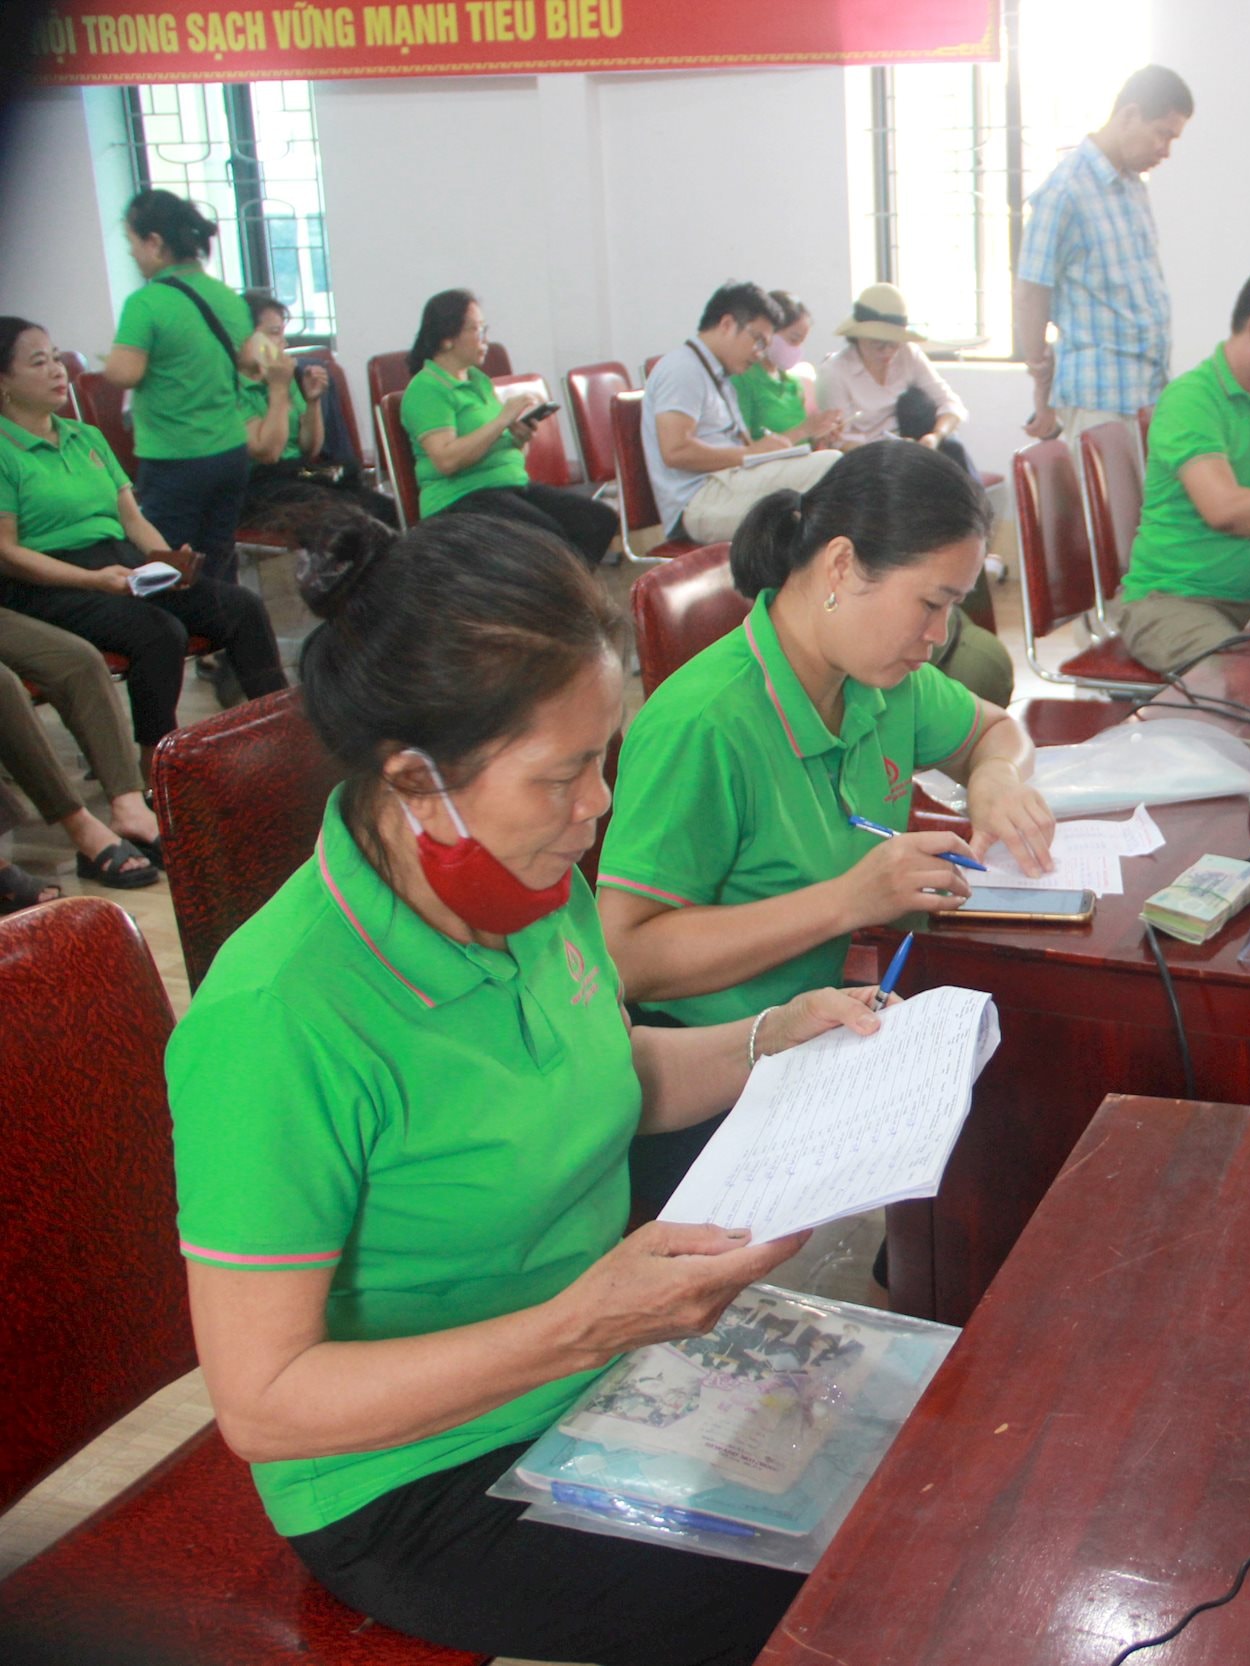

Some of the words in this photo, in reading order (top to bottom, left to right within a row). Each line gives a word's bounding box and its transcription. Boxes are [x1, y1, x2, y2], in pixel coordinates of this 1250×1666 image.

[82, 13, 180, 54] TRONG
[185, 10, 267, 60] SẠCH
[272, 2, 356, 50] VỮNG
[363, 3, 458, 54] MẠNH
